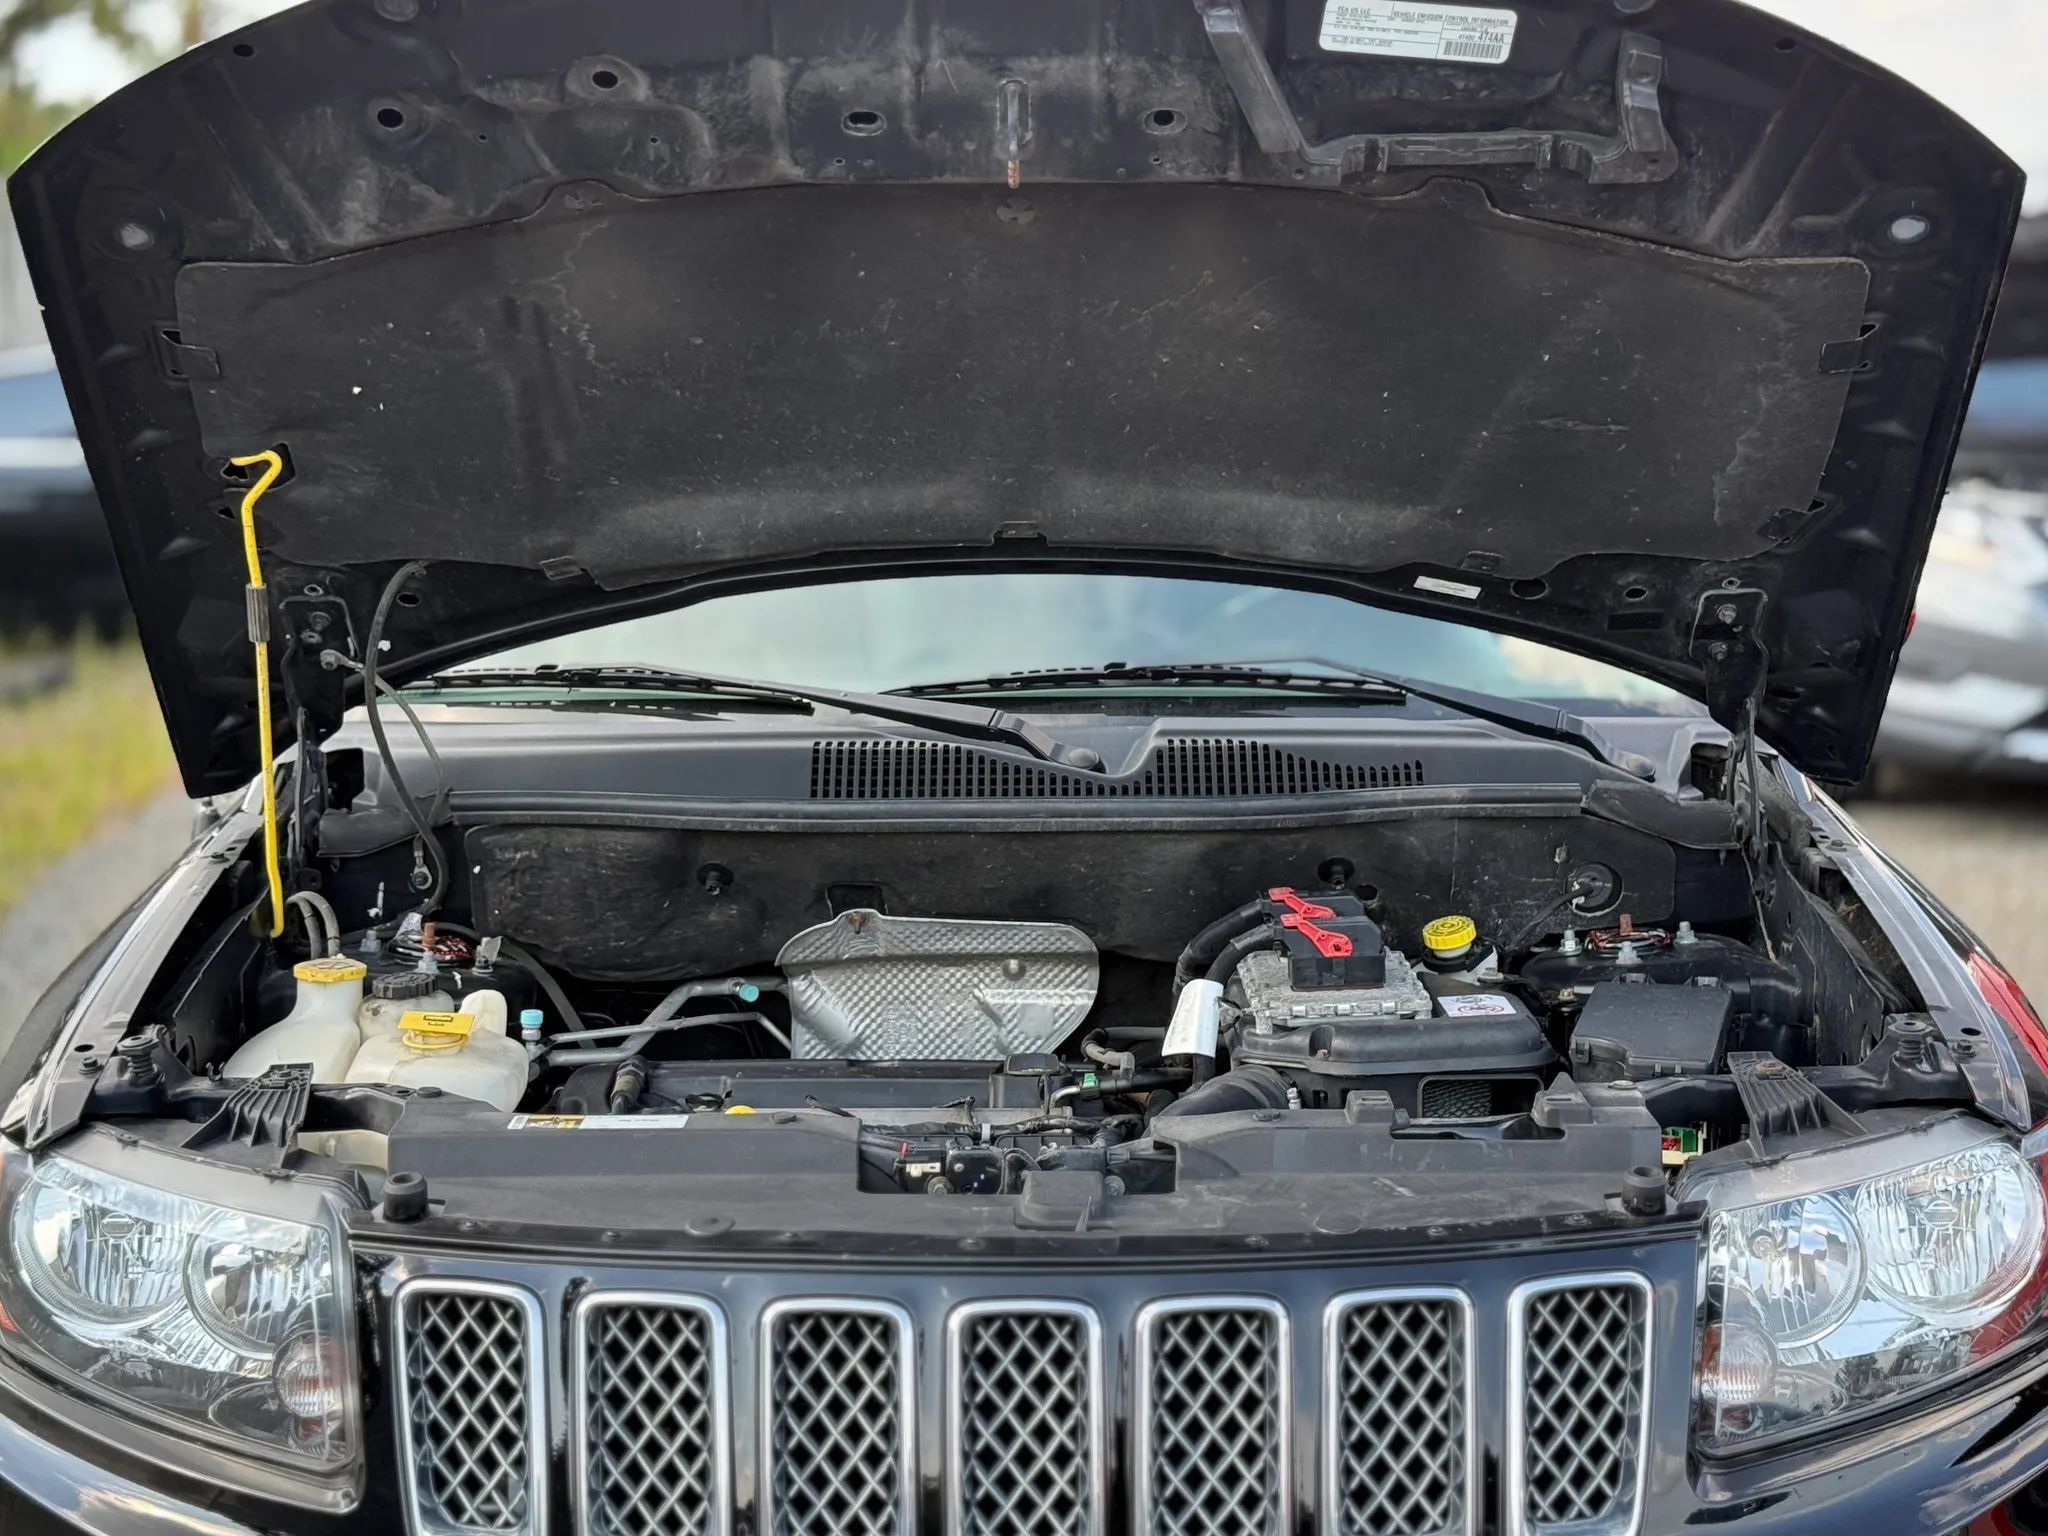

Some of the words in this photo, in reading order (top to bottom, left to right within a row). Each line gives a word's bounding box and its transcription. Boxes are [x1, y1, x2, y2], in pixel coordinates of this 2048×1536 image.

[1393, 11, 1416, 19] VEHICLE
[1417, 13, 1443, 22] EMISSION
[1444, 15, 1468, 23] CONTROL
[1471, 17, 1509, 26] INFORMATION
[1478, 32, 1504, 44] 474AA
